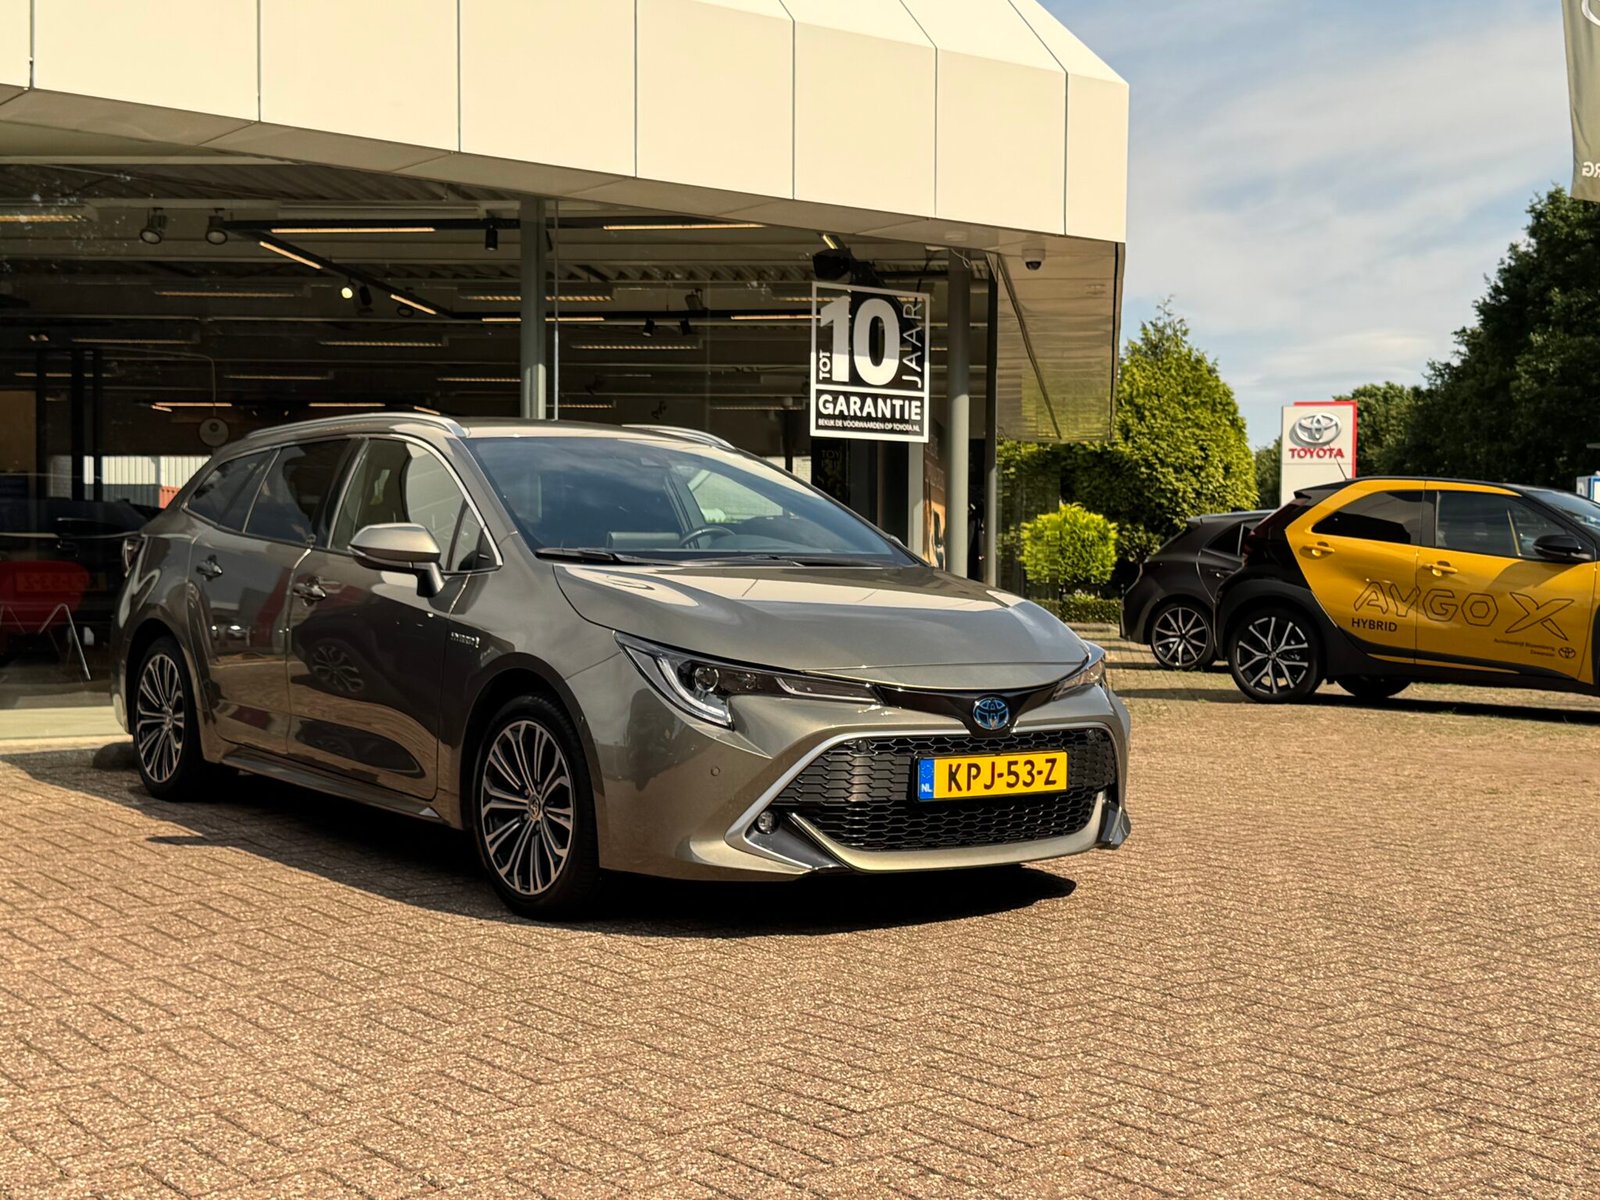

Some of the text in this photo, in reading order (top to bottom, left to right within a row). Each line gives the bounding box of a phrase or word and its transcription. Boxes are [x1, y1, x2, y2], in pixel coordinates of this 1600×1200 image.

[819, 295, 900, 386] 10
[902, 303, 922, 389] JAAR
[819, 350, 831, 380] TOT
[818, 394, 921, 421] GARANTIE
[835, 419, 843, 428] DE
[843, 420, 885, 430] VOORWAARDEN
[885, 422, 893, 430] OP
[1289, 447, 1345, 459] TOYOTA
[1351, 617, 1398, 633] HYBRID
[1353, 581, 1576, 641] AYGO X
[921, 784, 933, 793] NL
[947, 758, 1057, 792] KPJ-53-Z
